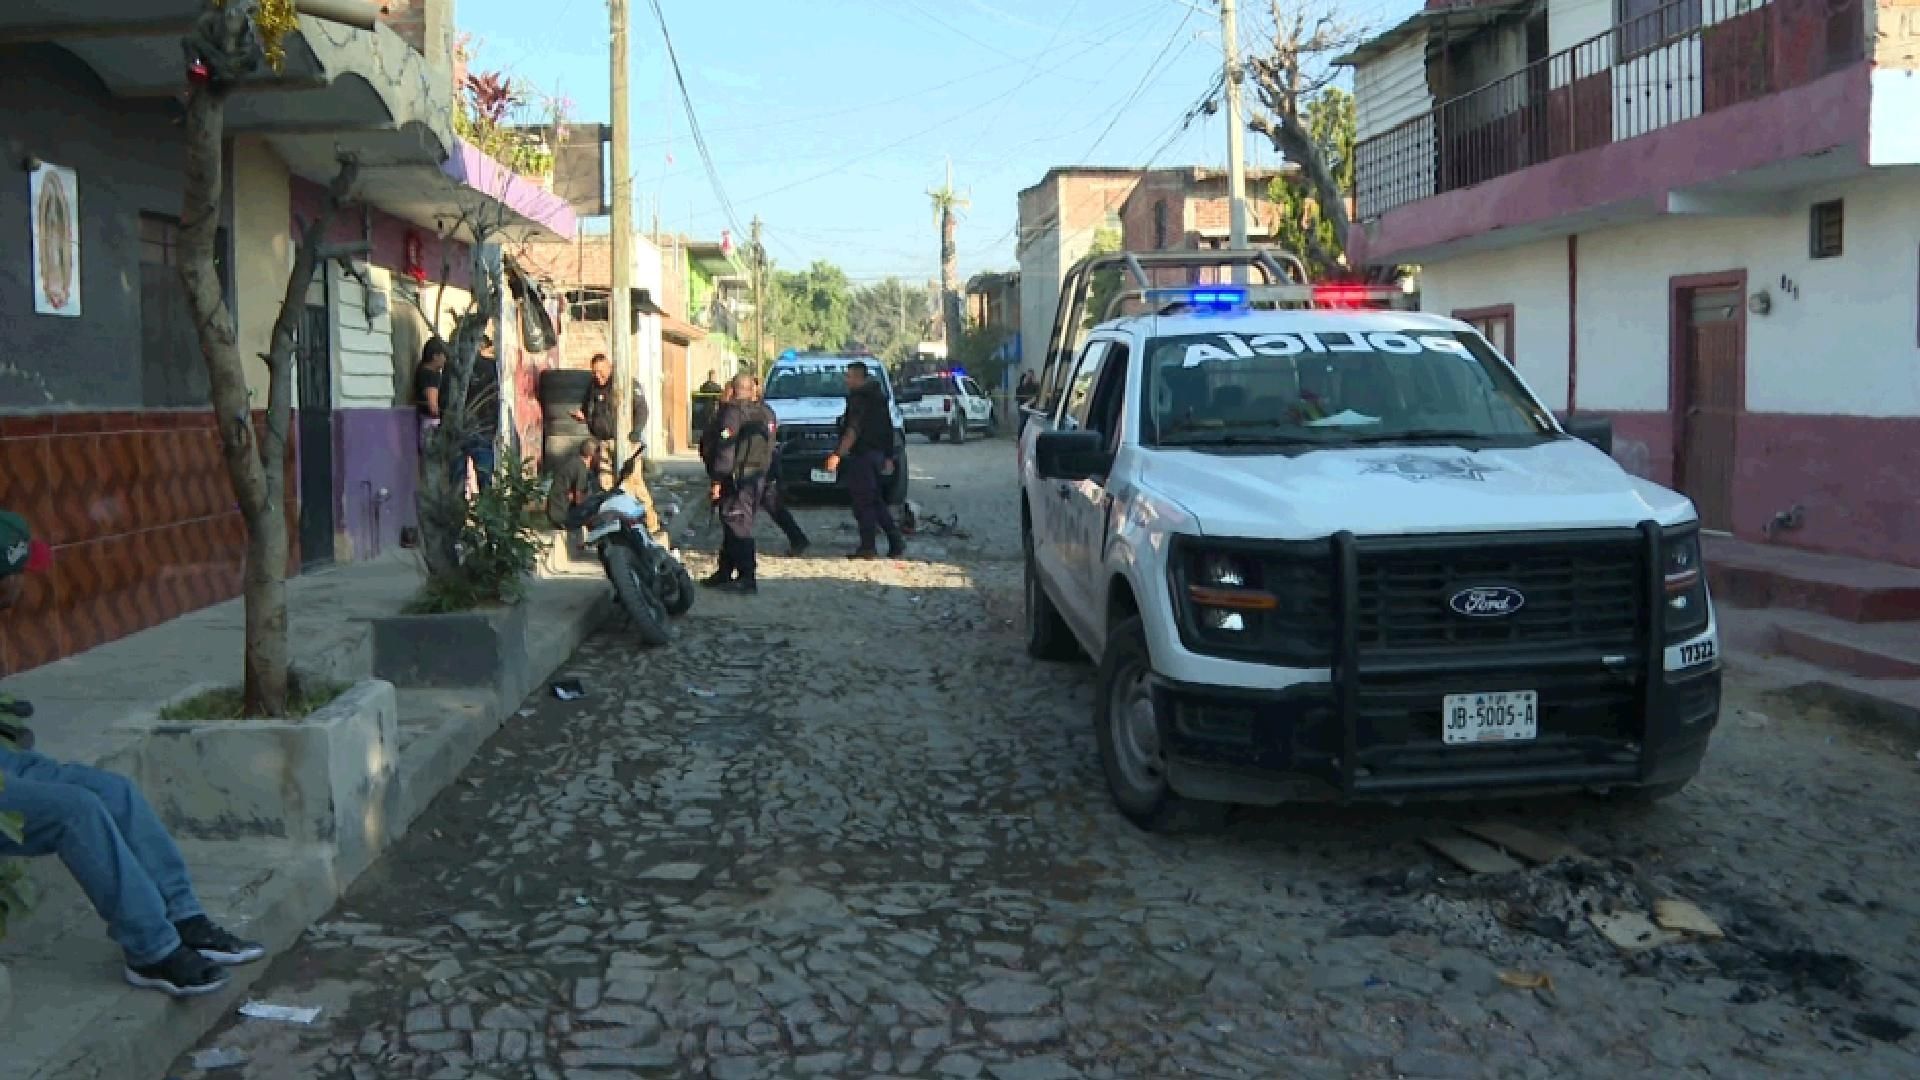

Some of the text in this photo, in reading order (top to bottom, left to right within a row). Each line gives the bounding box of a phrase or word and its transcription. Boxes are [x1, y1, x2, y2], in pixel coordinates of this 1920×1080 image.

[1465, 590, 1511, 614] Ford
[1680, 640, 1715, 664] 17322
[1447, 704, 1535, 730] JB-5005-A
